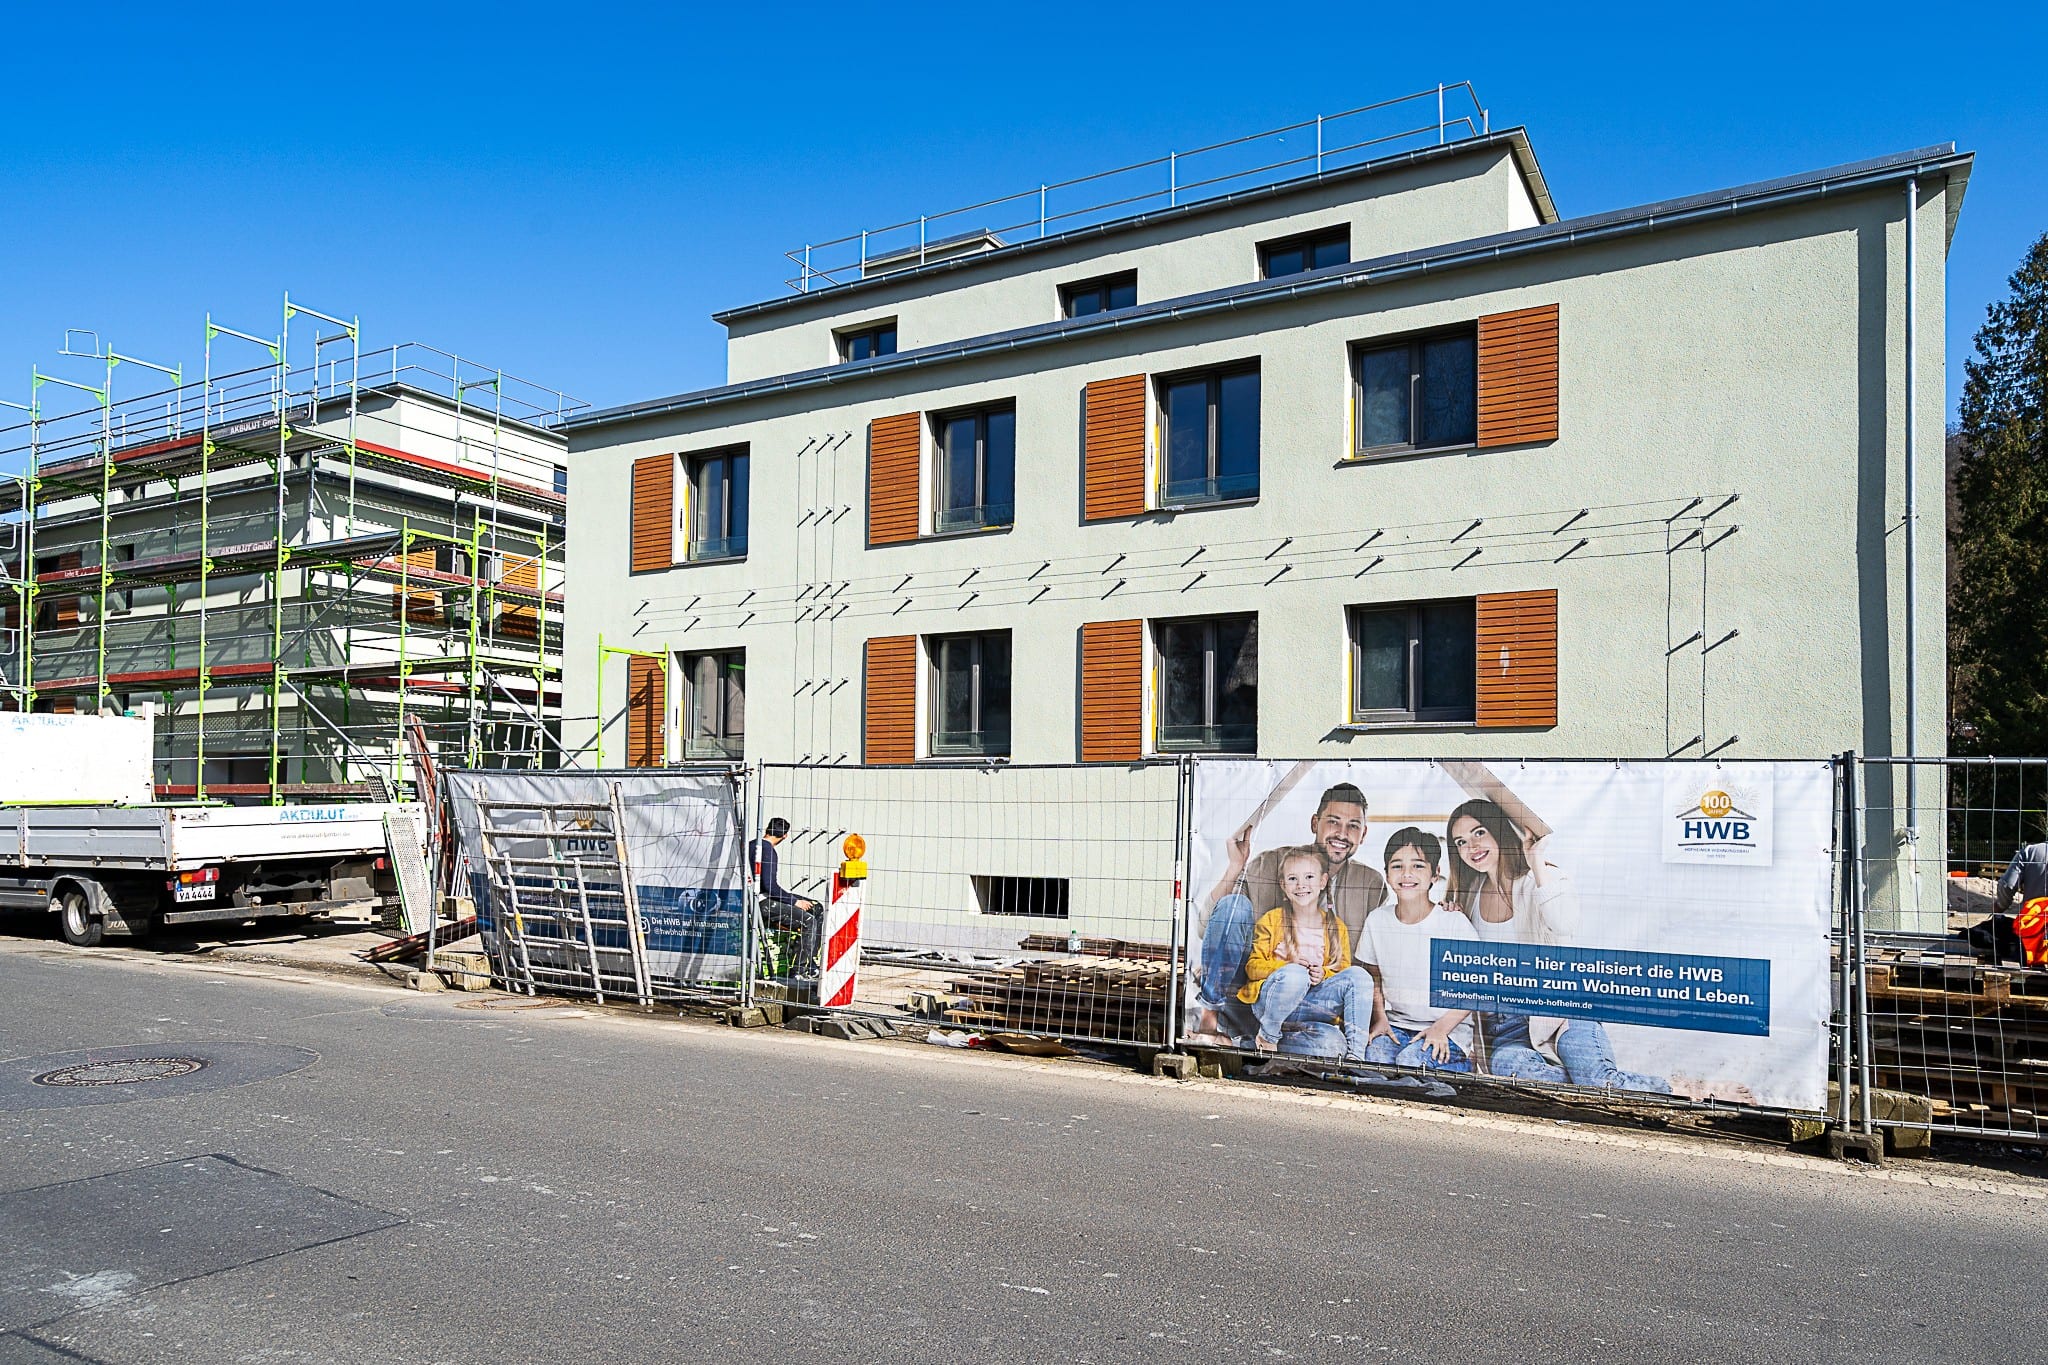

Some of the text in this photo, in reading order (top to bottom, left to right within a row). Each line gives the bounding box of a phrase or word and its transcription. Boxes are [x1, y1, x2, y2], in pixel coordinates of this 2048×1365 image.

[230, 420, 261, 435] AKBULUT
[220, 541, 273, 555] AKBULUT GmbH
[1703, 795, 1730, 809] 100
[1684, 821, 1750, 840] HWB
[567, 838, 609, 852] HWB
[651, 916, 730, 930] Die HWB auf Instagram
[1441, 950, 1517, 969] Anpacken
[1535, 956, 1566, 971] hier
[1570, 960, 1643, 978] realisiert
[1647, 964, 1674, 980] die
[1679, 966, 1724, 983] HWB
[1442, 971, 1755, 1006] neuen Raum zum Wohnen und Leben.
[1441, 988, 1495, 1002] #hwbhofheim
[1501, 995, 1593, 1010] www.hwb-hofheim.de
